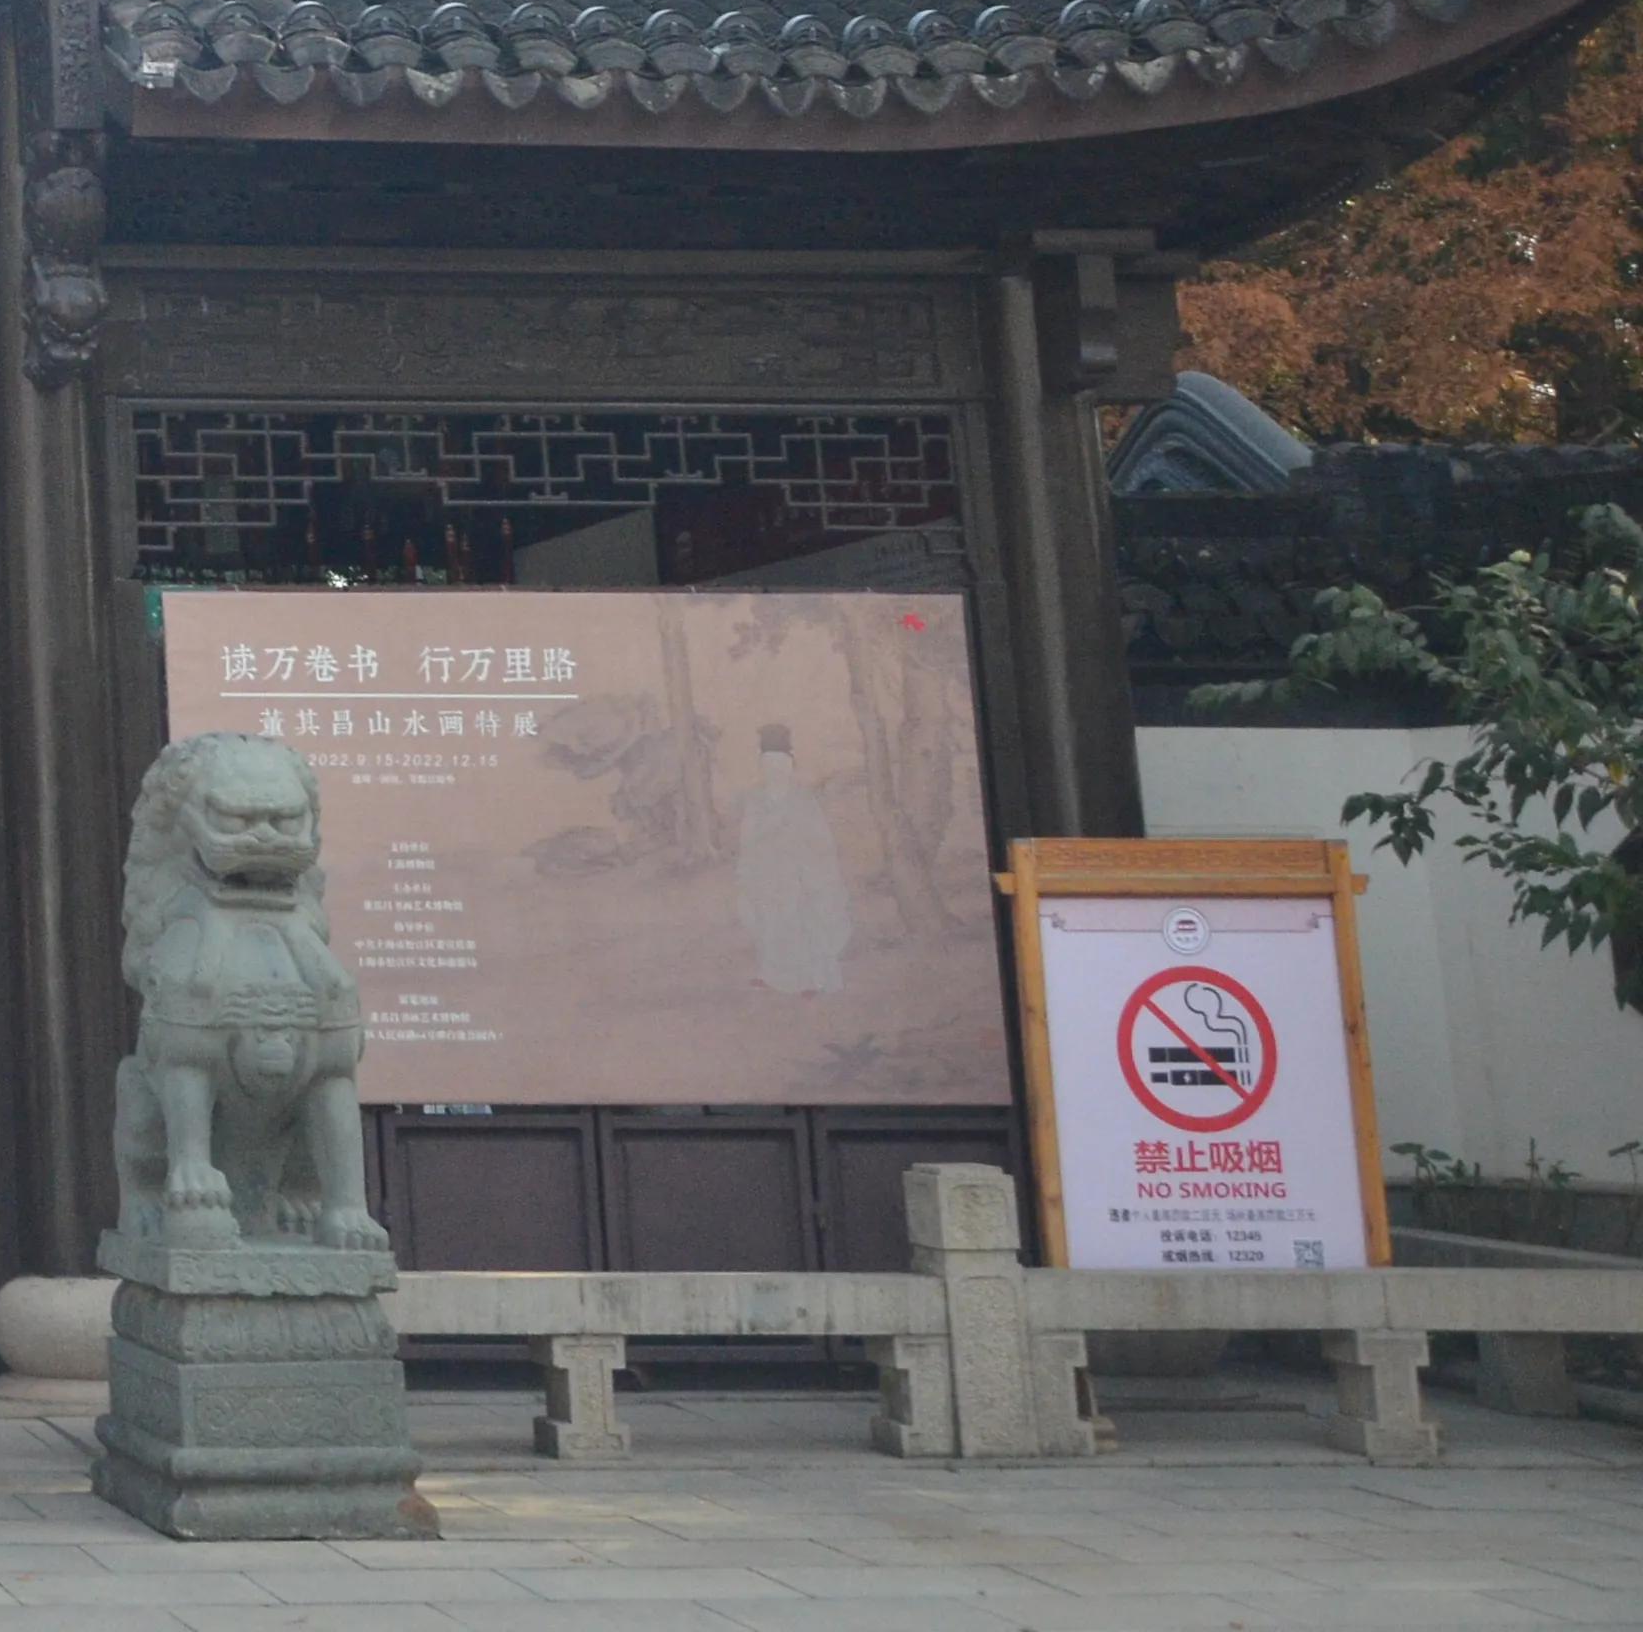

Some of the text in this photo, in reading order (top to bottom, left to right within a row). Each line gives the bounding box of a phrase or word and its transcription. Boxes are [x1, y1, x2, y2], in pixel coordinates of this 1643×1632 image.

[220, 643, 578, 685] 读万卷书 行万里路
[257, 707, 539, 738] 董其昌山水画特展
[307, 753, 499, 768] 2022.9.15-2022.12.15
[1133, 1139, 1284, 1176] 禁止吸烟
[1137, 1181, 1288, 1200] NO SMOKING
[1224, 1229, 1263, 1242] 12345
[1227, 1249, 1265, 1263] 12320
